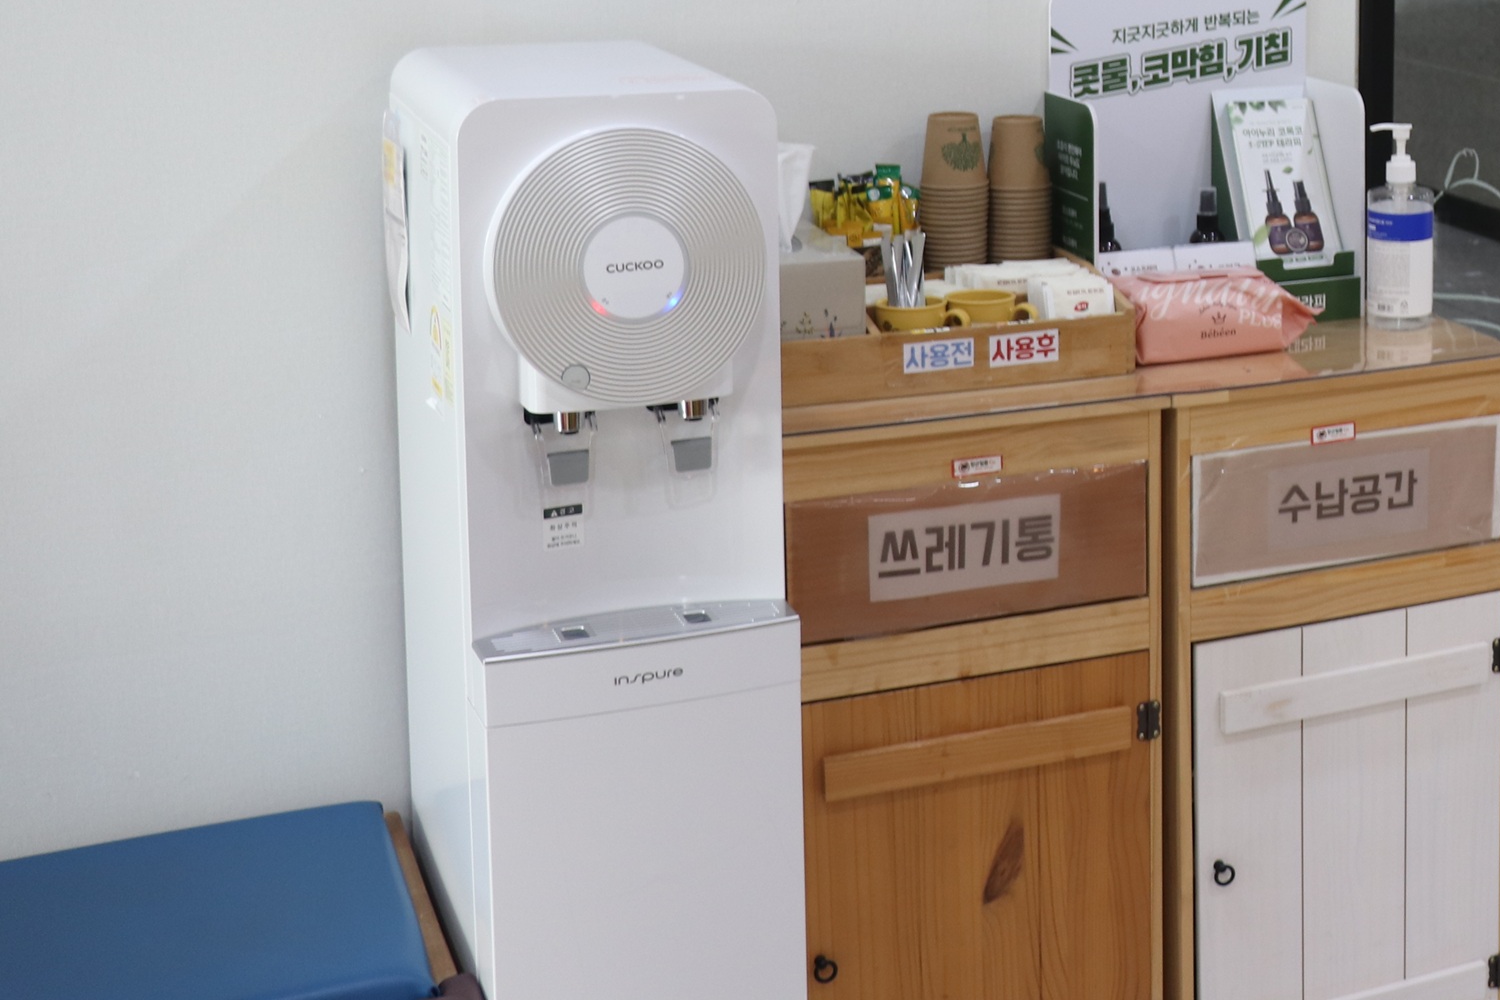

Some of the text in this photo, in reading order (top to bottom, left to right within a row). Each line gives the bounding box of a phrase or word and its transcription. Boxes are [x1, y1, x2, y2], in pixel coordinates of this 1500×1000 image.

[1204, 9, 1260, 31] 반복되는
[1242, 127, 1276, 138] 아이누리
[606, 259, 664, 274] CUCKOO
[905, 340, 973, 370] 사용전
[991, 332, 1057, 363] 사용후
[1276, 468, 1419, 524] 수납공간
[878, 514, 1057, 579] 쓰레기통
